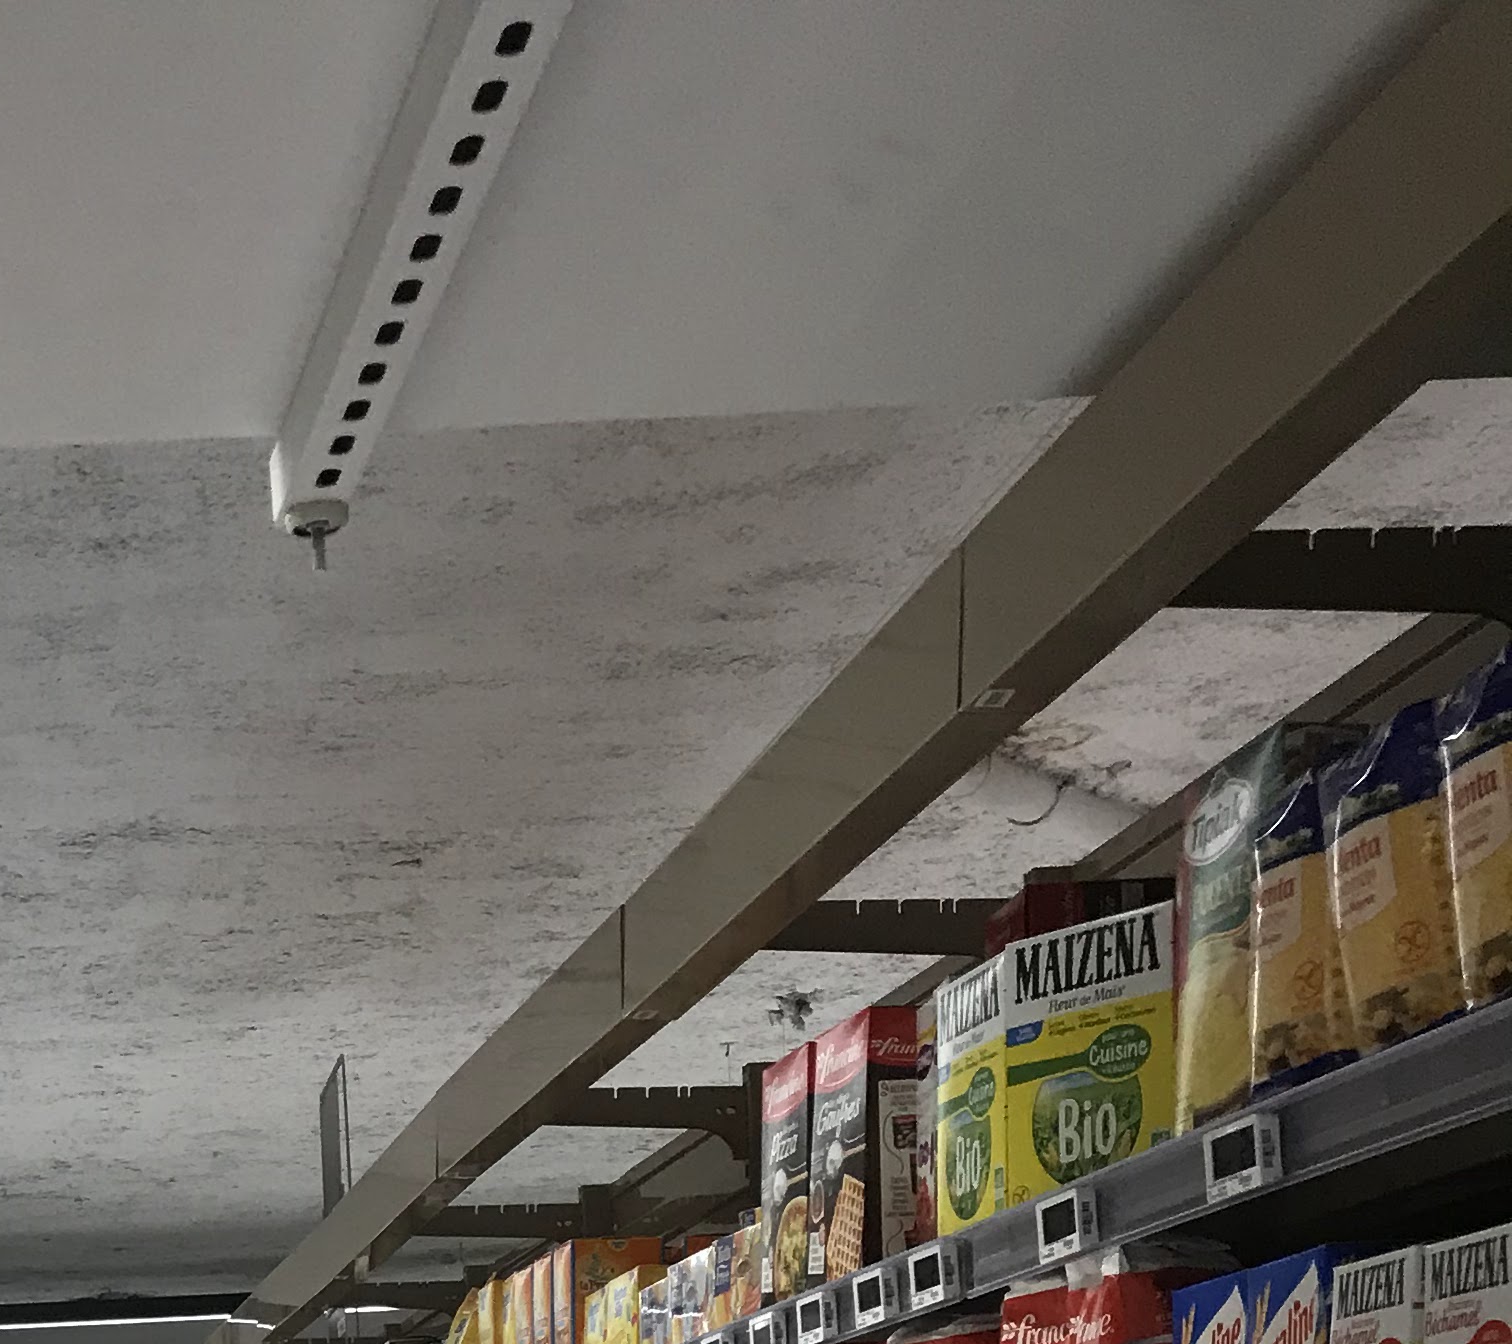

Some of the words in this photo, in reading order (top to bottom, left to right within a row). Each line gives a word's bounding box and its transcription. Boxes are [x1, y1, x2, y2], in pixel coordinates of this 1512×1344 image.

[1015, 912, 1160, 1005] MAIZENA
[940, 965, 1000, 1046] MAIZENA
[1089, 1036, 1148, 1067] Cuisine
[1058, 1099, 1117, 1164] Bio
[955, 1136, 984, 1196] Bio
[1336, 1257, 1406, 1320] MAIZENA
[1430, 1234, 1511, 1301] MAIZENA
